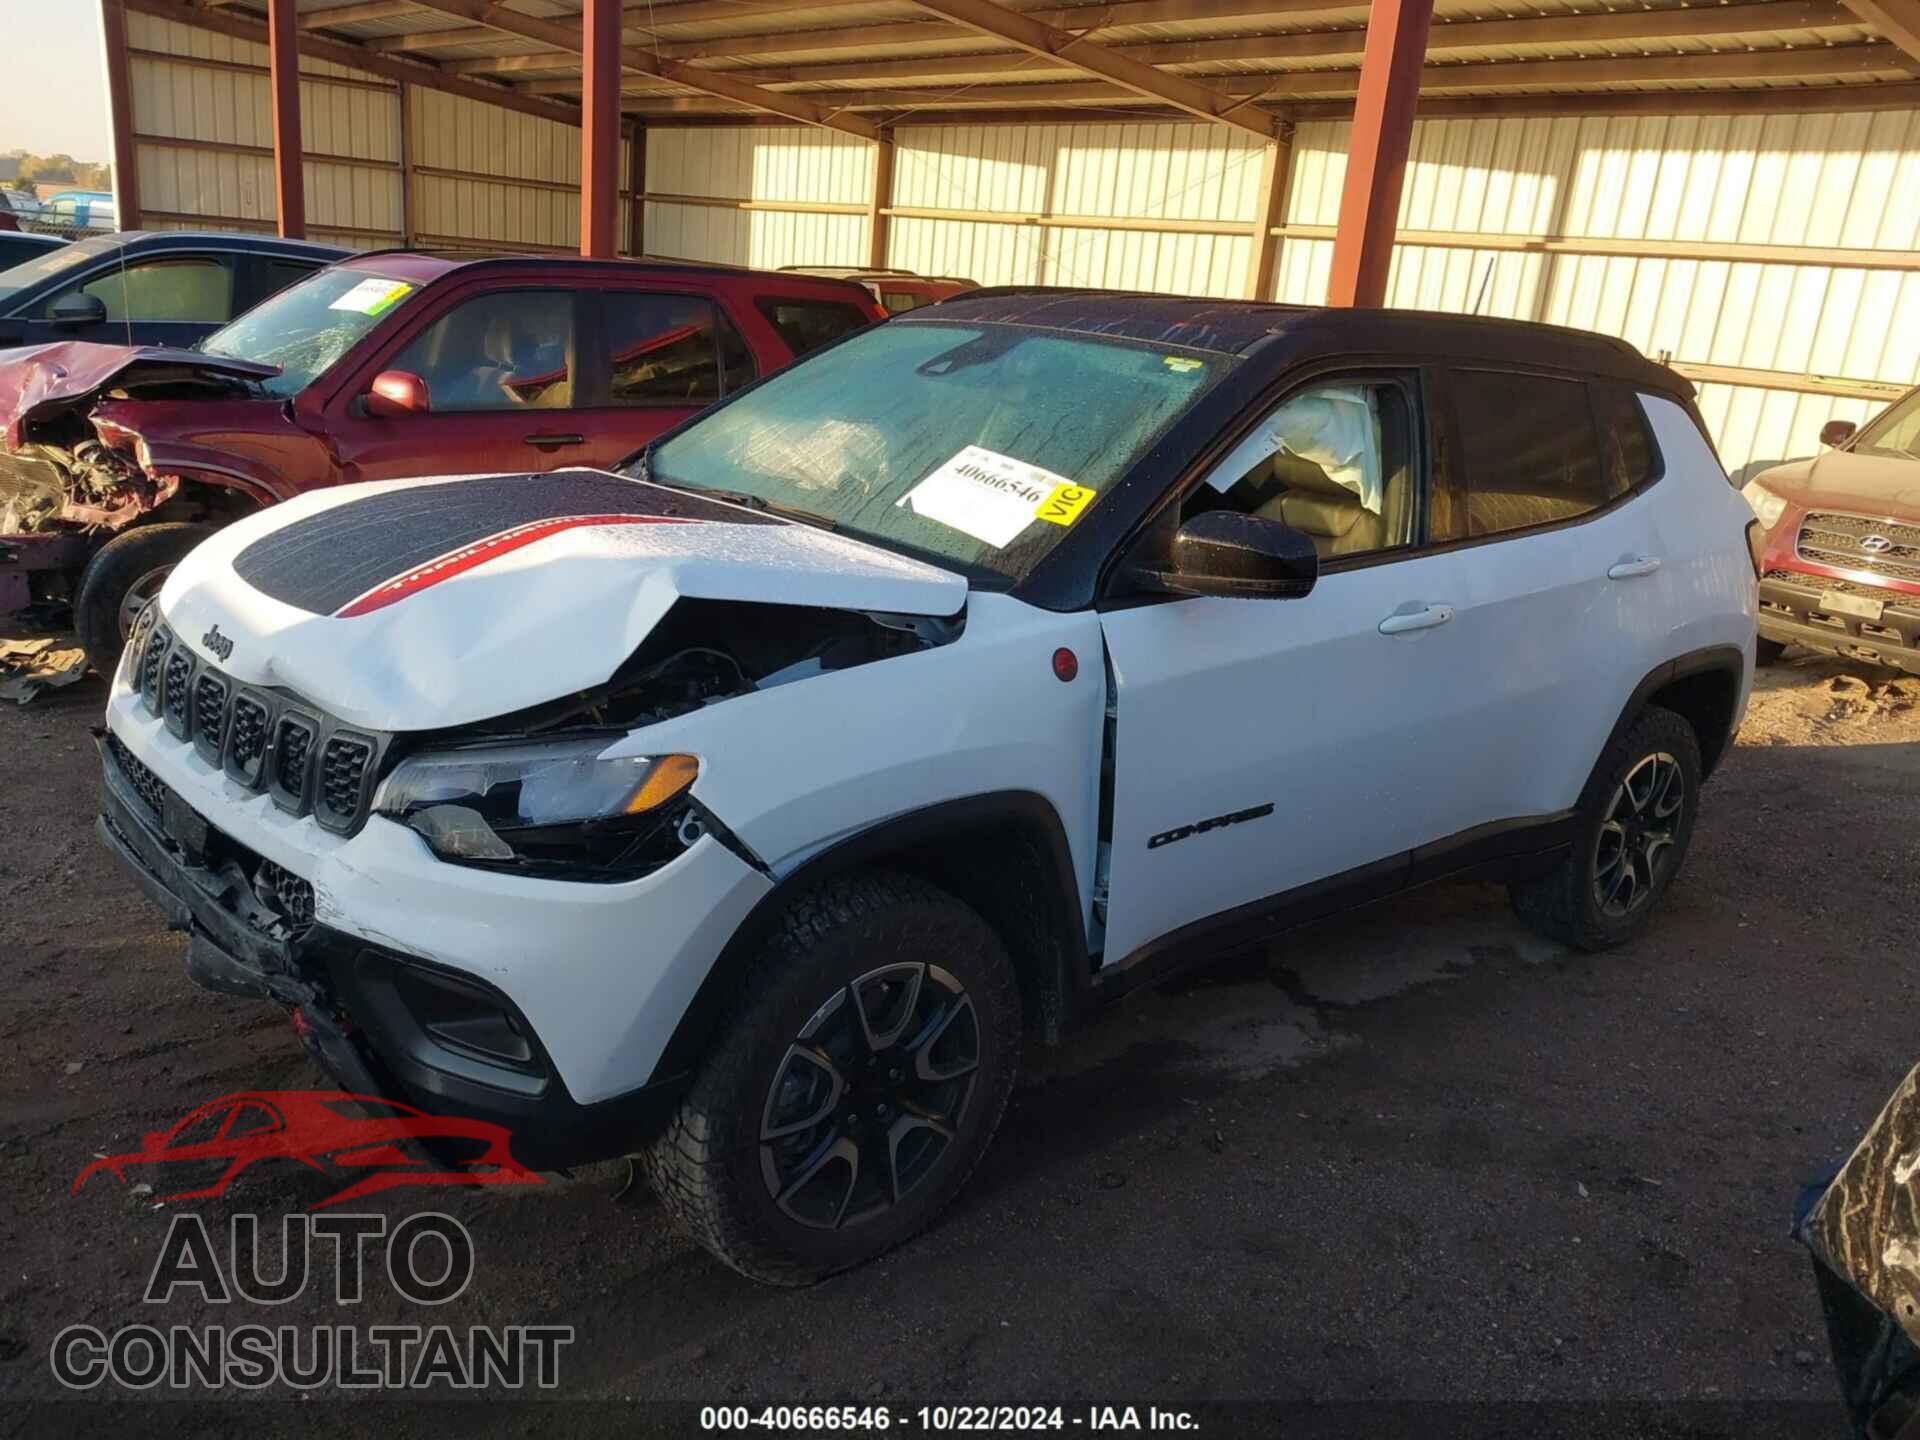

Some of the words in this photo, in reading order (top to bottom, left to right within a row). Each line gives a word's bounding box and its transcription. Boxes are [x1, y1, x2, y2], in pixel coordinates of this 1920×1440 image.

[955, 463, 1043, 503] 40666546
[1045, 487, 1084, 517] VIC
[202, 623, 234, 664] Jeep
